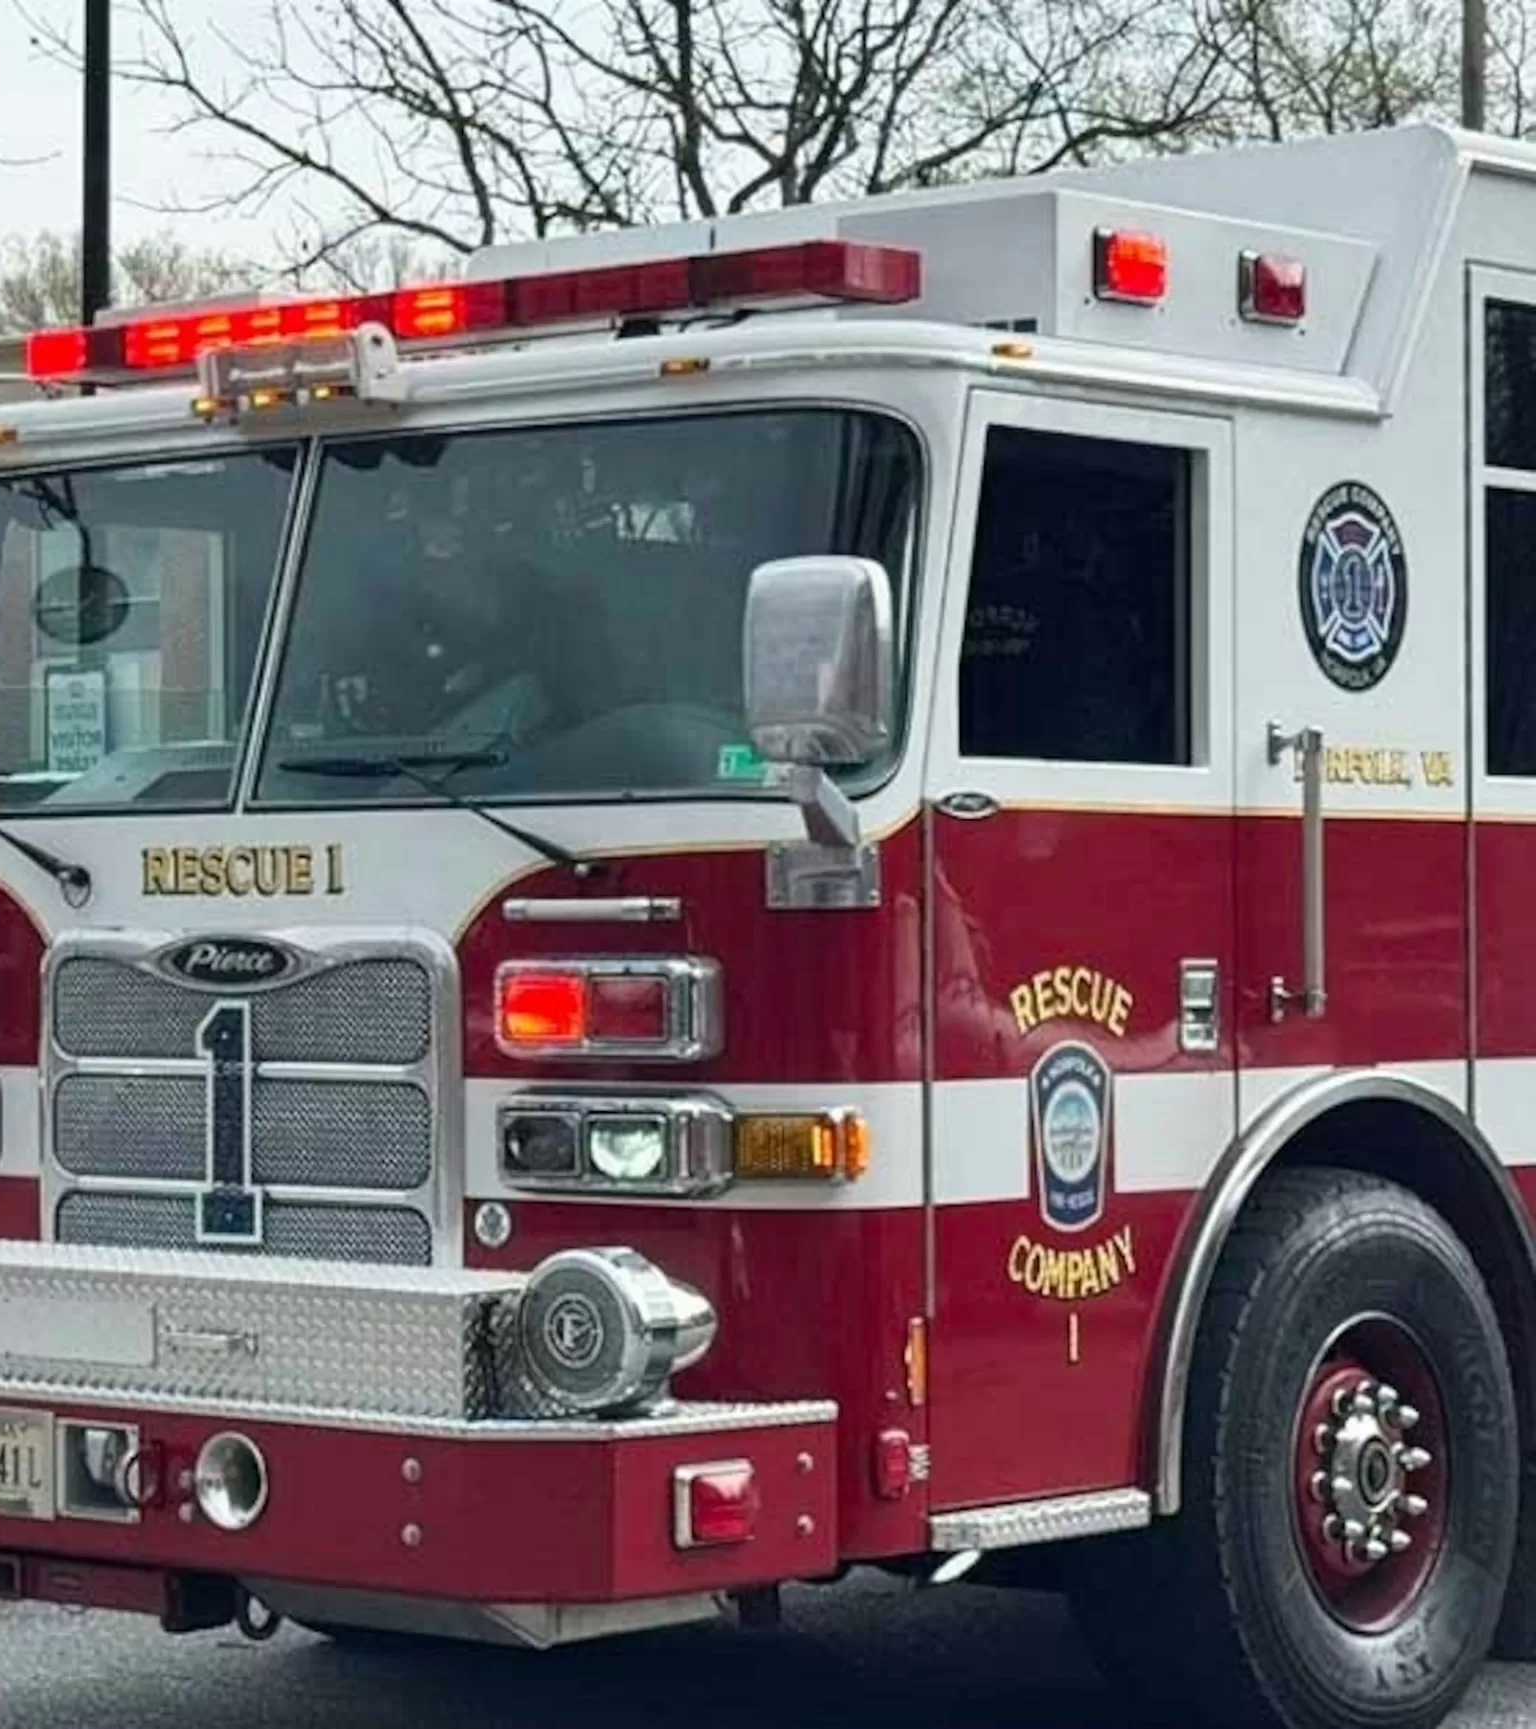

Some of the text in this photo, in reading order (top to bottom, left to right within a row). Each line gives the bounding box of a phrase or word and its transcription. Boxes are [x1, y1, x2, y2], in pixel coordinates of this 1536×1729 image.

[141, 843, 345, 896] RESCUE 1
[185, 942, 275, 973] Pierce
[1009, 965, 1134, 1037] RESCUE
[195, 999, 263, 1244] 1
[1007, 1224, 1136, 1299] COMPANY
